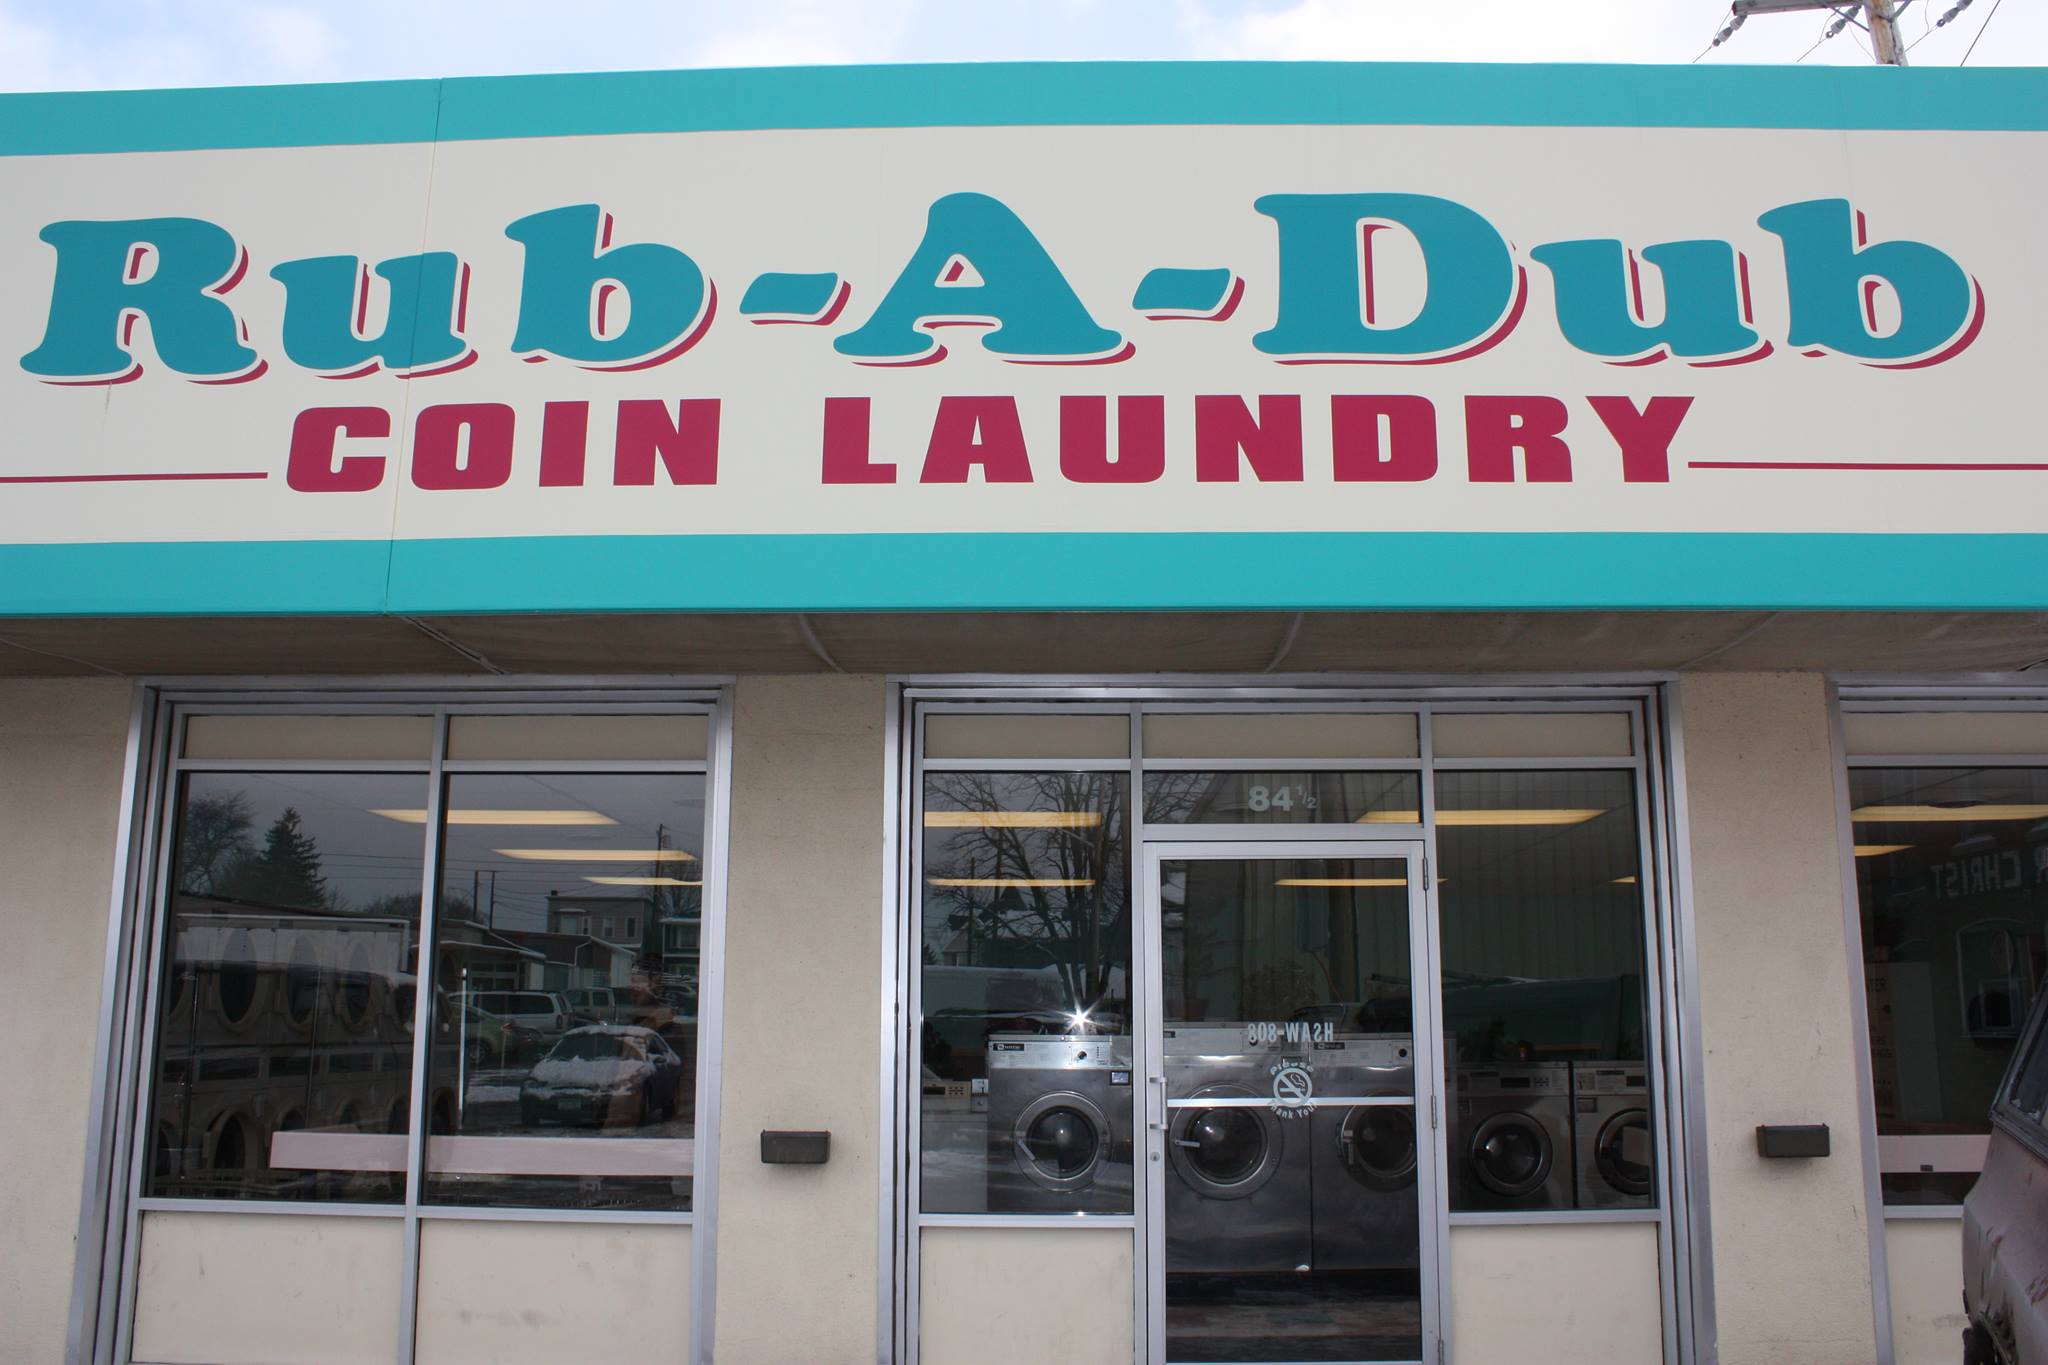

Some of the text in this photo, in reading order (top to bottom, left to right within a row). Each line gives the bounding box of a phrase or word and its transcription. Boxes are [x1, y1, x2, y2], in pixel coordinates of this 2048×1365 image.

[20, 192, 1984, 385] Rub-A-Dub
[286, 394, 1695, 493] COIN LAUNDRY
